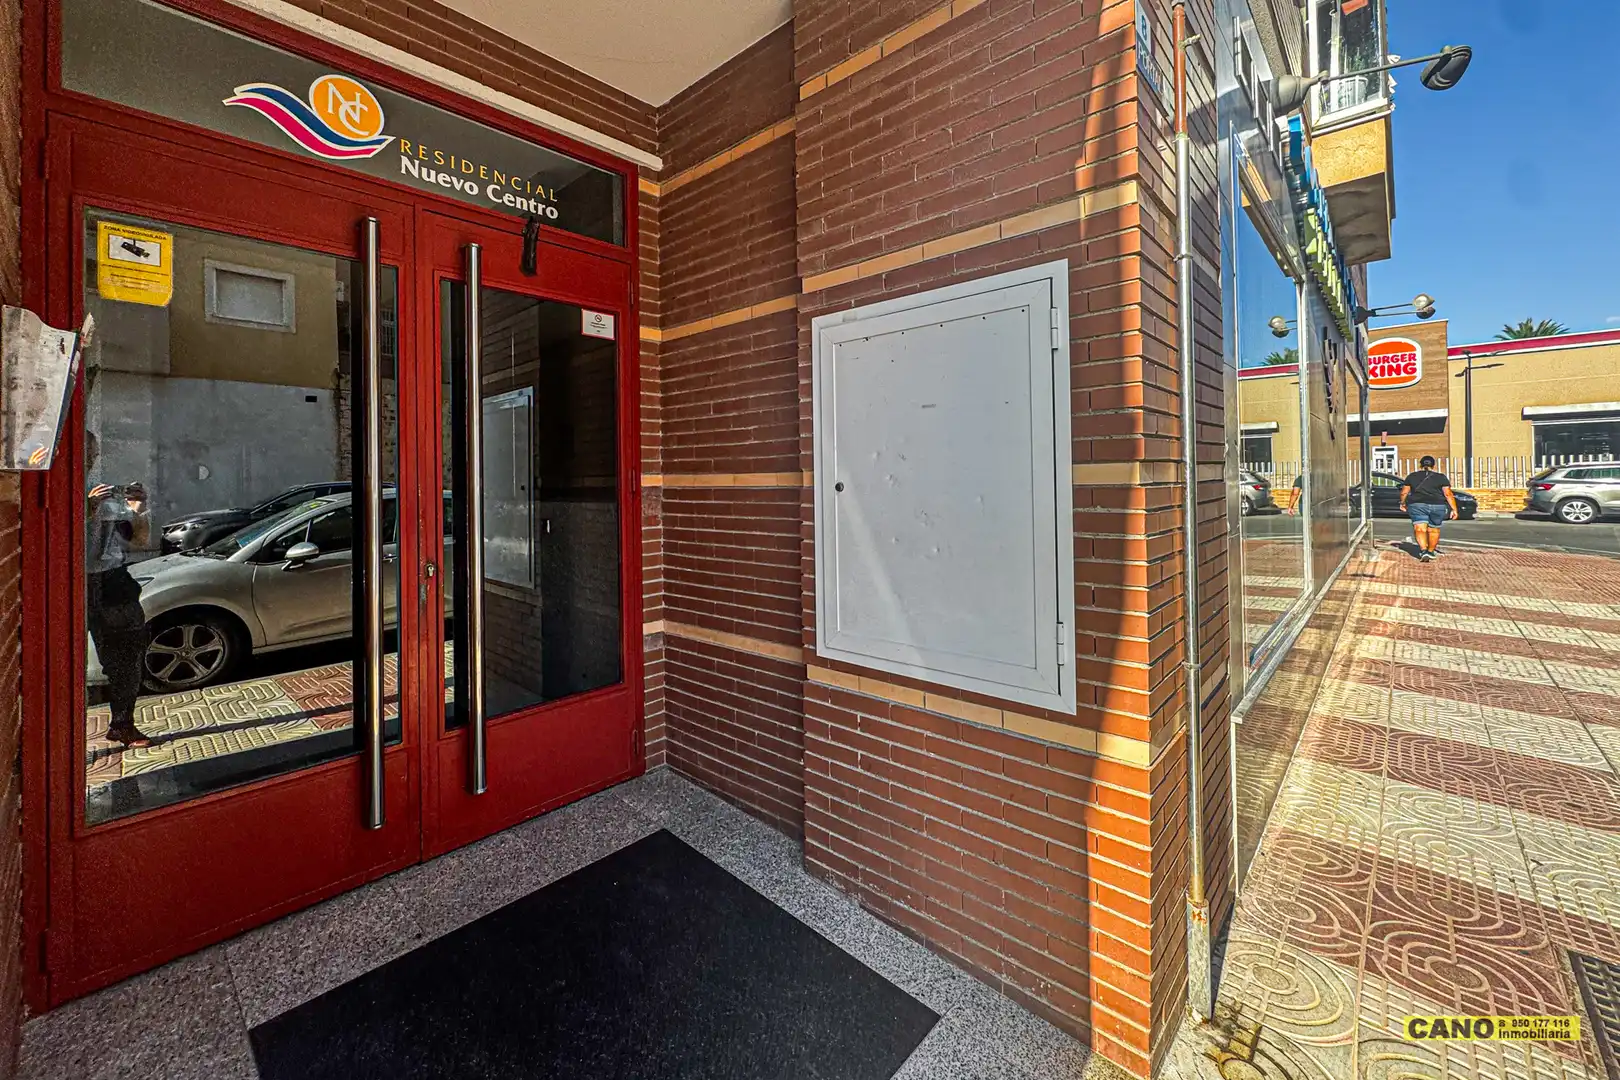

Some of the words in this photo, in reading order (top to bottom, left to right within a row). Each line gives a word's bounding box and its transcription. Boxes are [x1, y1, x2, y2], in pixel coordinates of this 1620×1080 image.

[400, 138, 558, 202] RESIDENCIAL
[400, 155, 479, 195] Nuevo
[486, 184, 559, 219] Centro
